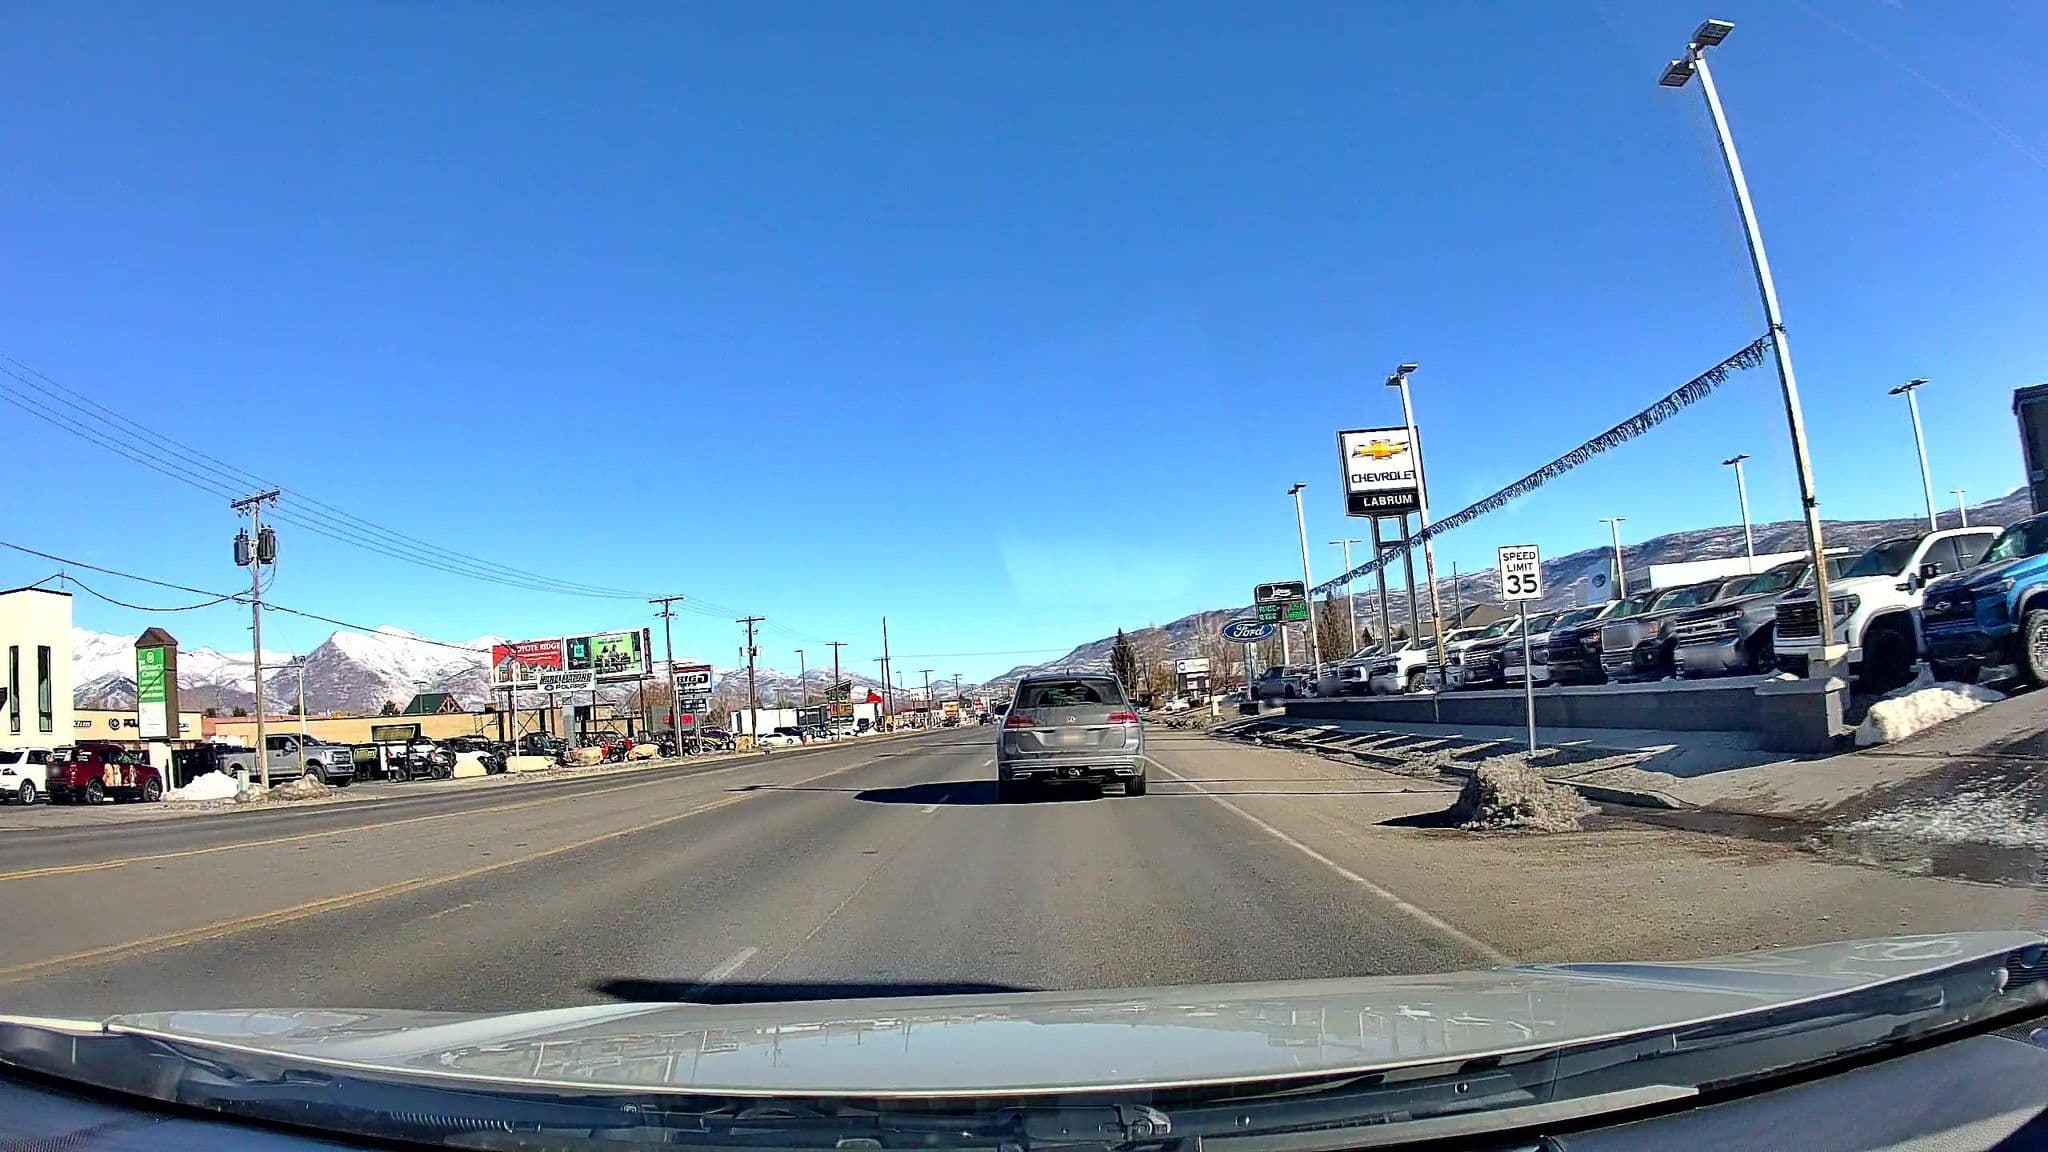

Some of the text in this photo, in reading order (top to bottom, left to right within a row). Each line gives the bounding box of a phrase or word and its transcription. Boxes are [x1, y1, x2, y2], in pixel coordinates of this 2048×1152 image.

[1352, 470, 1416, 483] CHEVROLET
[1363, 495, 1412, 507] LABRUM
[1503, 551, 1536, 561] SPEED
[1507, 562, 1533, 572] LIMIT
[1507, 573, 1537, 594] 35
[1233, 623, 1264, 638] Ford
[540, 642, 560, 650] RIDGE
